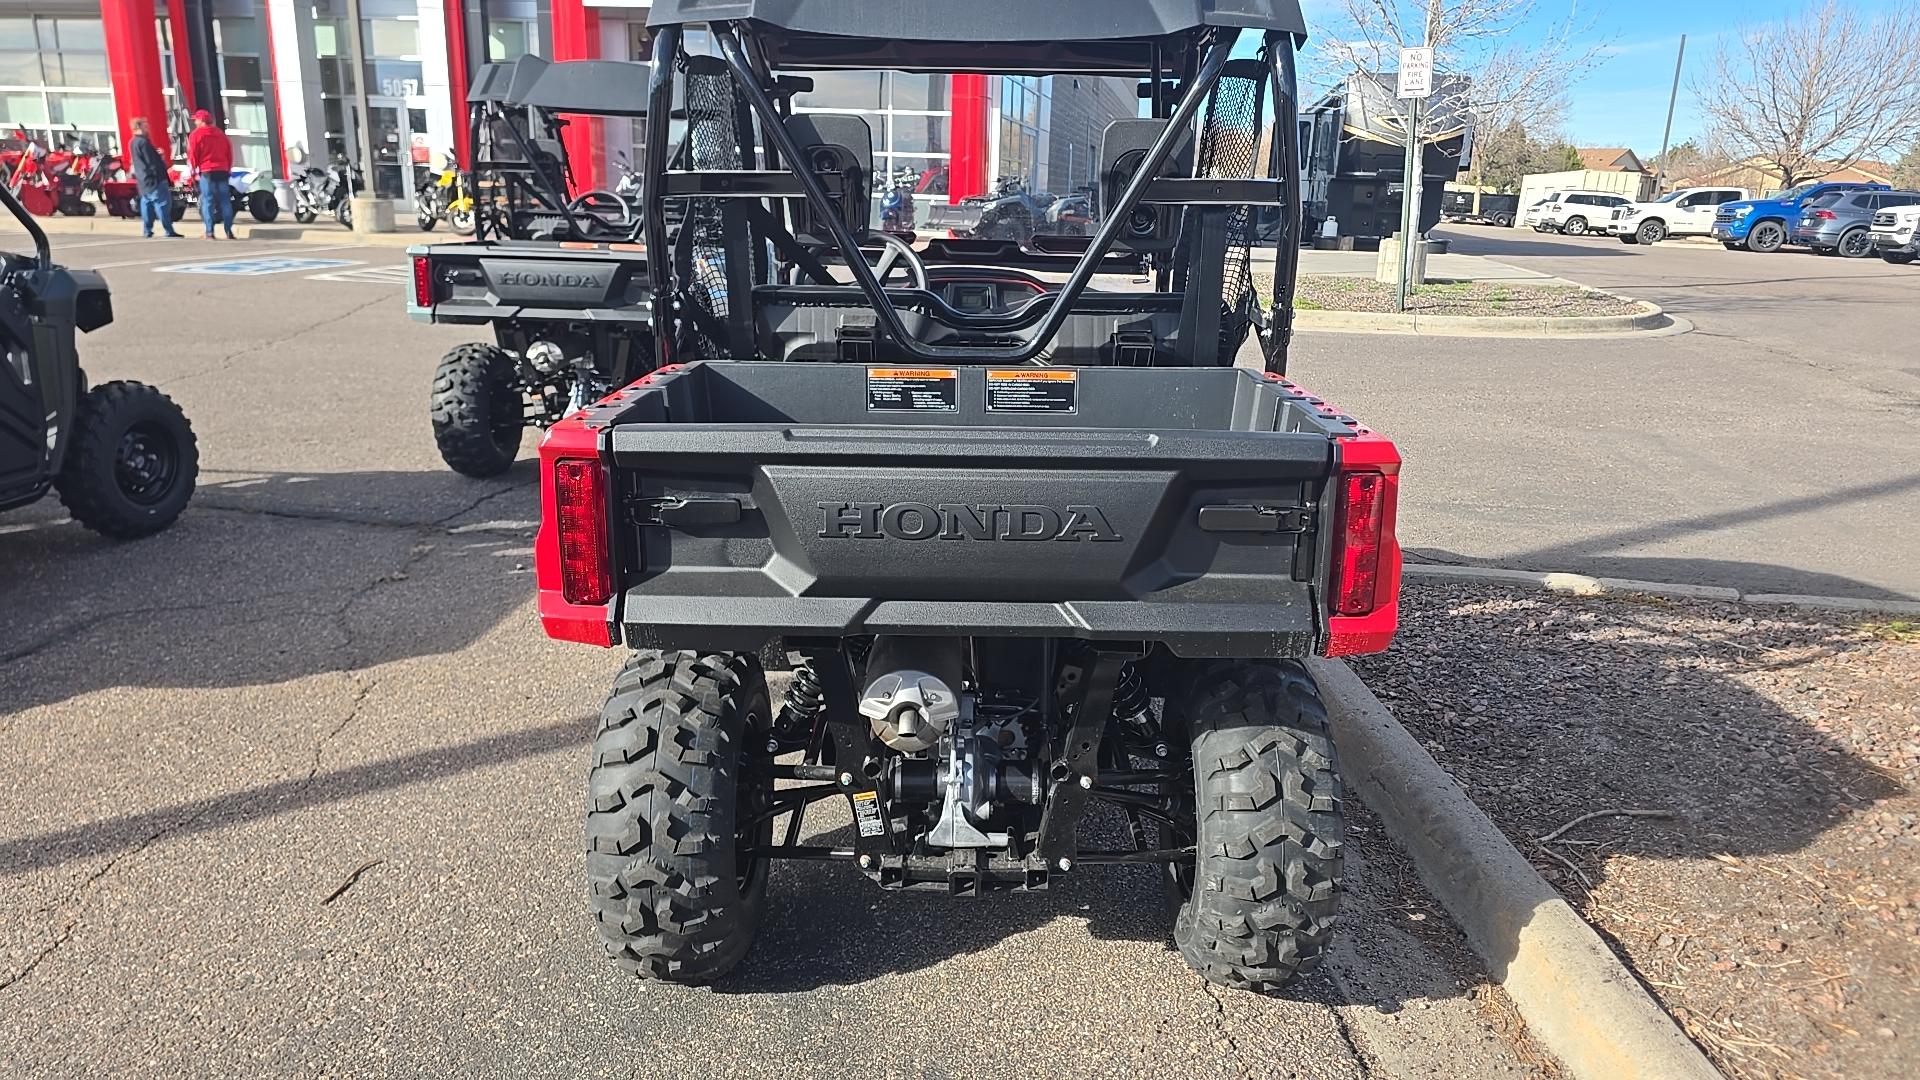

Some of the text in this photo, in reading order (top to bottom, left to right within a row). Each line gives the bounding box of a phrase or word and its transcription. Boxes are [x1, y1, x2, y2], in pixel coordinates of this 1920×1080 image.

[1410, 53, 1422, 61] NO
[382, 78, 418, 96] 5057
[498, 272, 603, 288] HONDA
[817, 501, 1124, 542] HONDA
